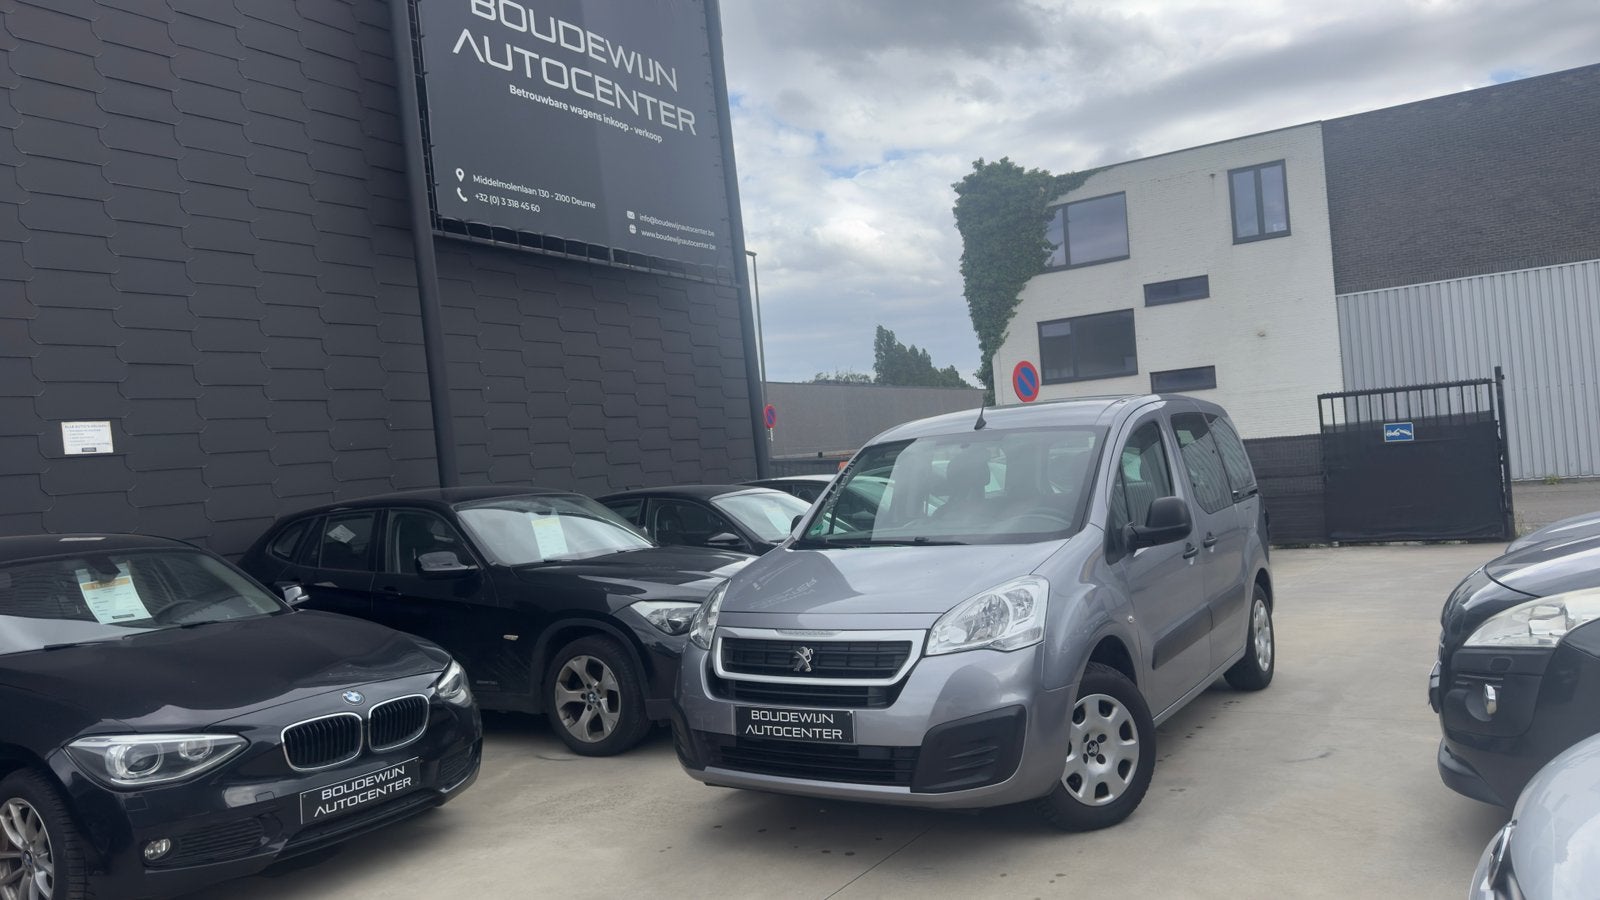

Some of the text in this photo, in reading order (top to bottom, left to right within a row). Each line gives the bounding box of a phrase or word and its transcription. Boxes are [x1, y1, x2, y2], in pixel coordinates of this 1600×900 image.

[471, 0, 678, 92] BOUDEWIJN
[452, 28, 697, 136] AUTOCENTER
[509, 84, 569, 111] Betrouwbare
[569, 104, 603, 122] wagens
[603, 113, 630, 132] inkoop
[634, 126, 663, 144] verkoop
[472, 174, 538, 196] Middelmolenlaan
[537, 188, 550, 199] 130
[554, 192, 571, 204] 2100
[571, 196, 596, 209] Deurne
[474, 192, 541, 213] +32 (0) 3 318 45 60
[745, 724, 842, 740] AUTOCENTER
[751, 709, 834, 724] BOUDEWIJN
[313, 776, 413, 818] AUTOCENTER
[321, 765, 405, 801] BOUDEWIJN
